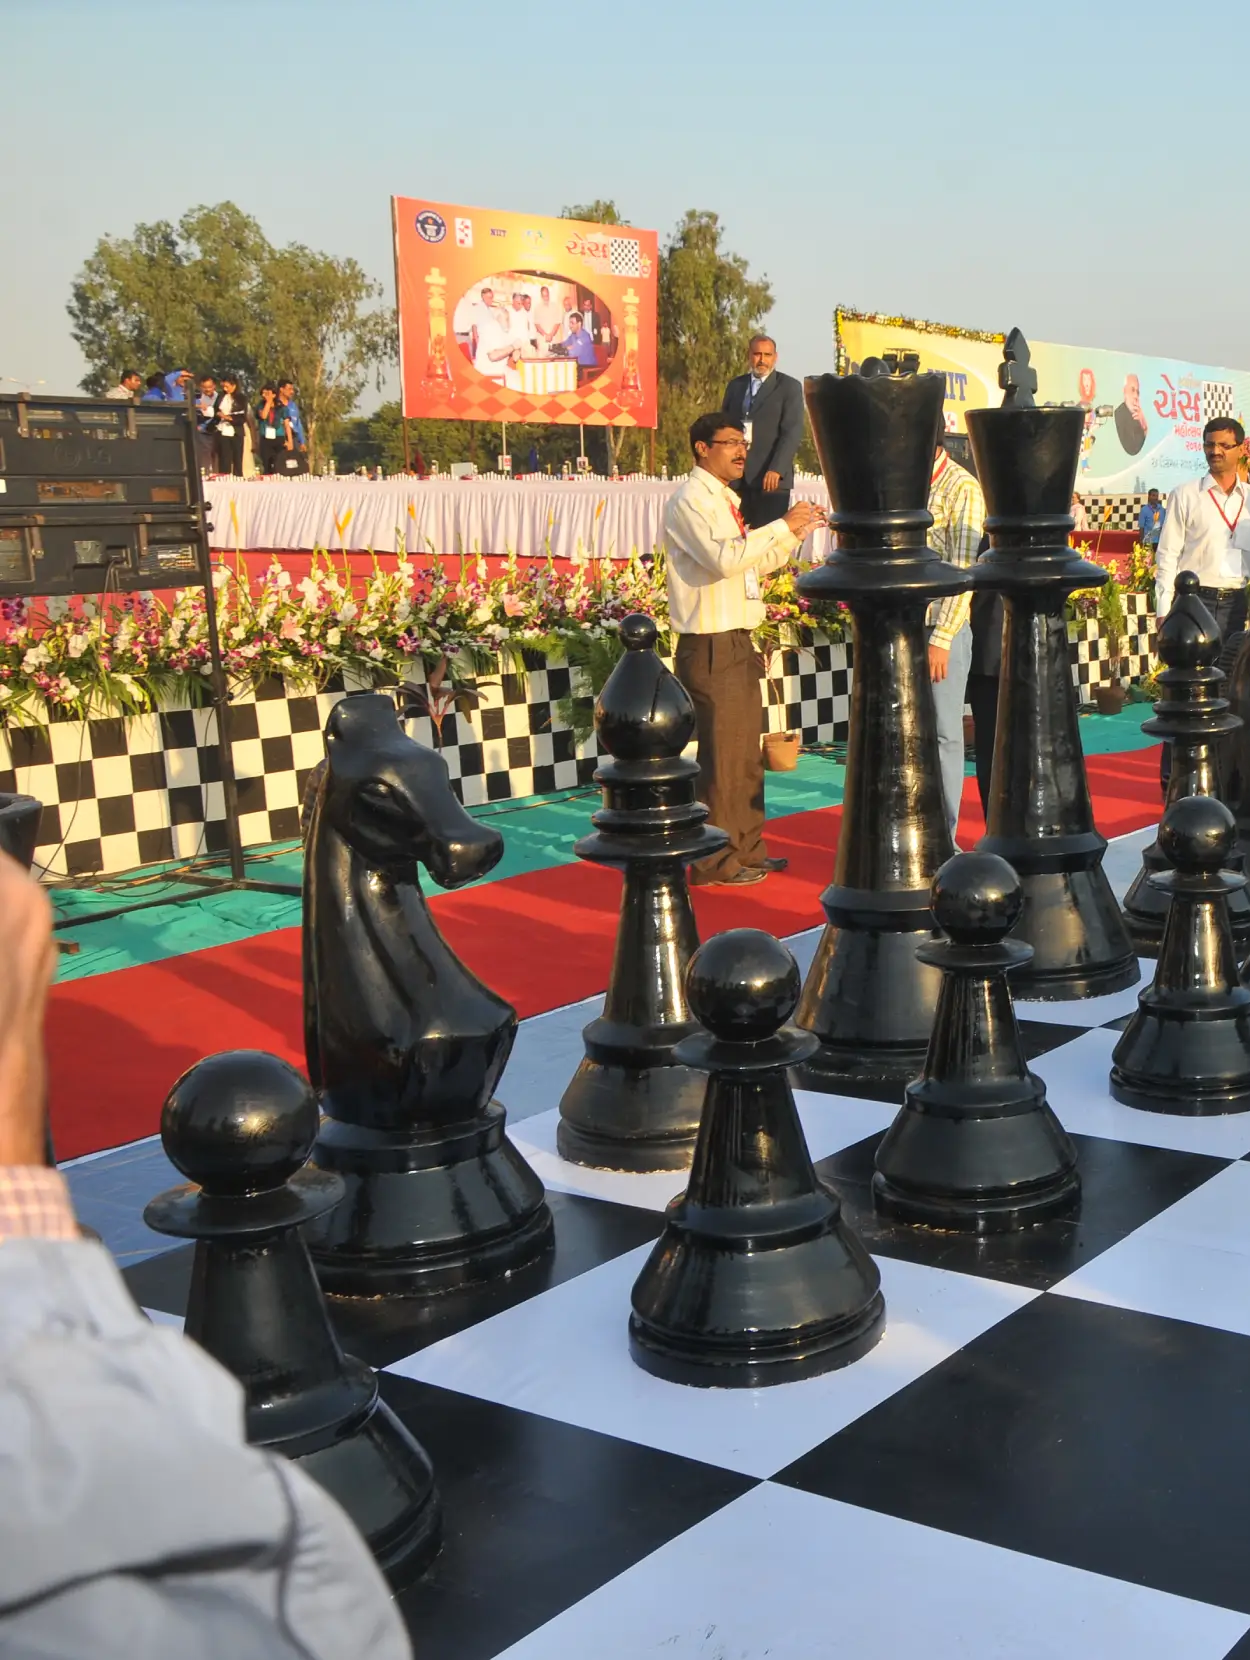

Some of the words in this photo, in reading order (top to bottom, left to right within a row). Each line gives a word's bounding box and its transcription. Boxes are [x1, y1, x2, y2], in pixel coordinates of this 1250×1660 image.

[490, 228, 506, 237] NIIT
[927, 368, 967, 401] IT
[1153, 374, 1201, 422] ચેસ
